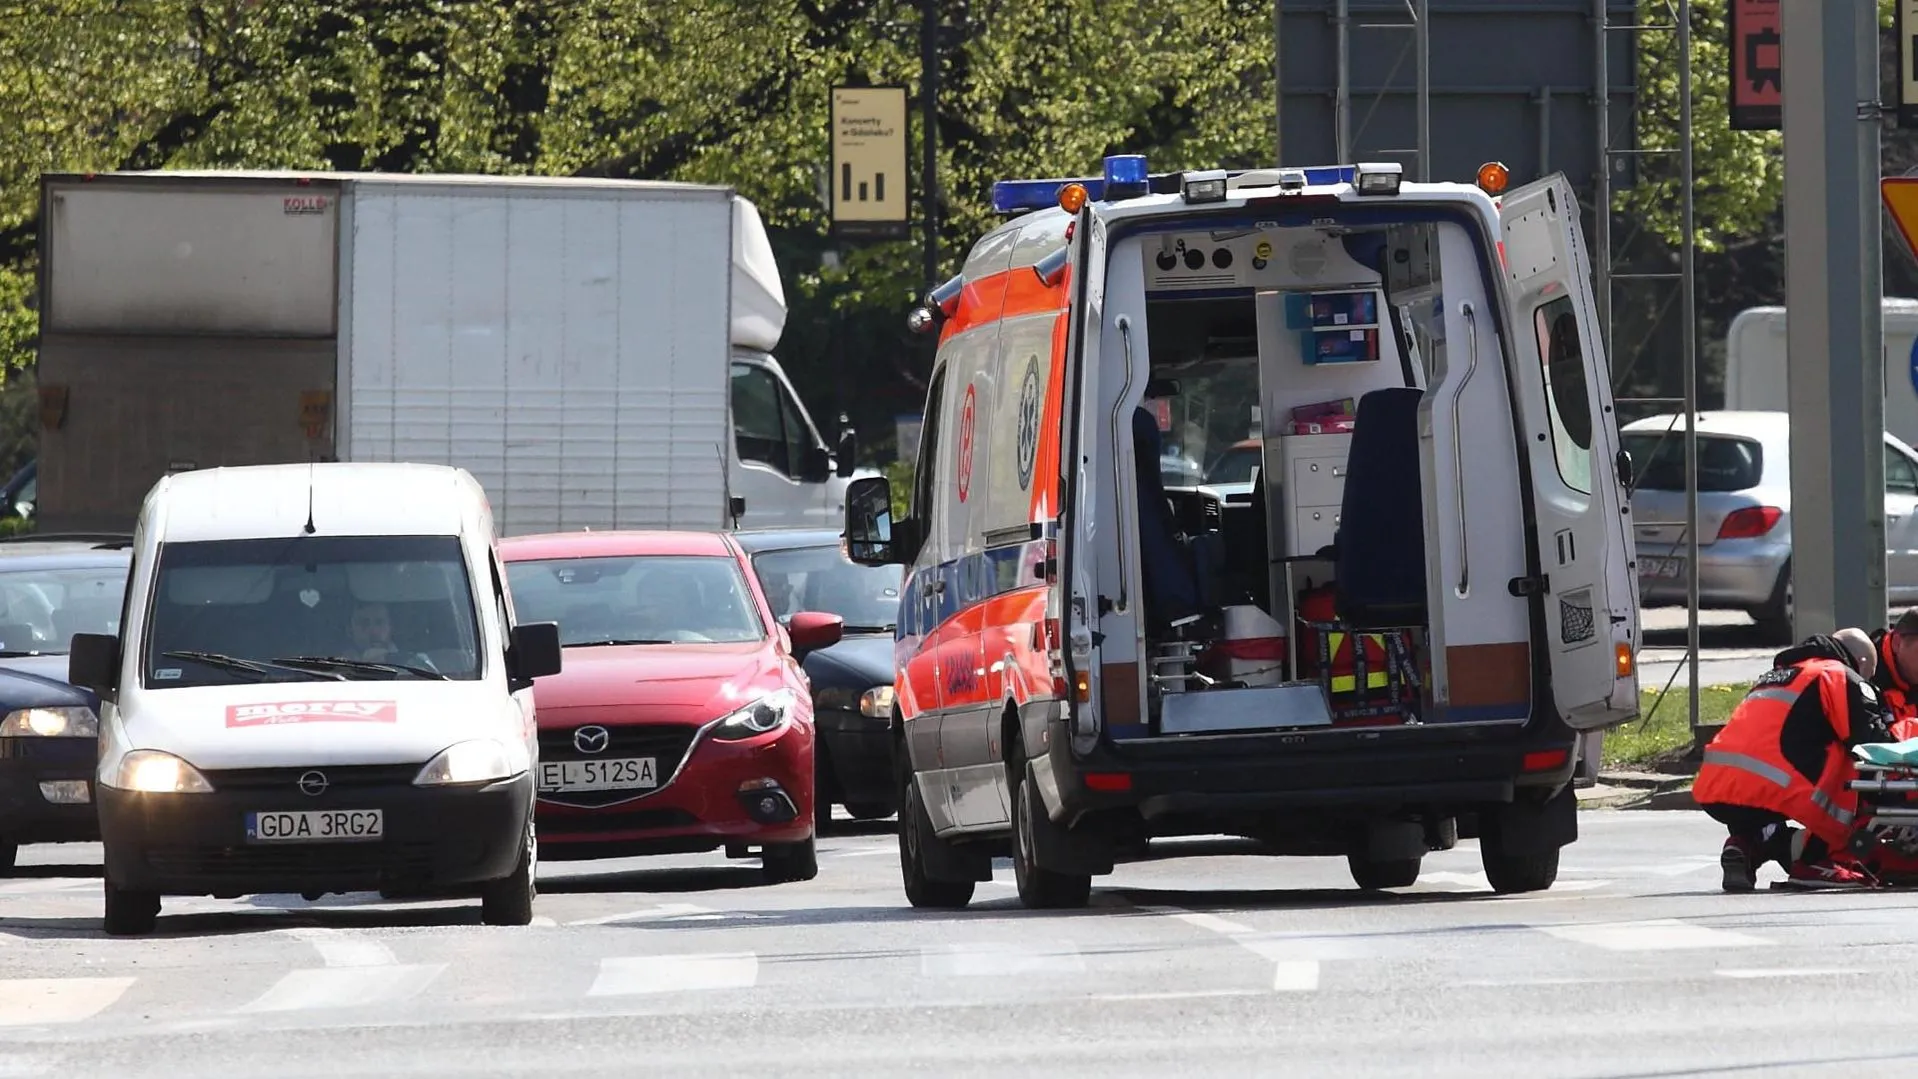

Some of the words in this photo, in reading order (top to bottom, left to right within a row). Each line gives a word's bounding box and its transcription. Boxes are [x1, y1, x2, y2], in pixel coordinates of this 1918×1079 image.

[543, 764, 576, 786] EL
[584, 760, 653, 784] 512SA
[261, 814, 312, 837] GDA
[320, 812, 379, 836] 3RG2
